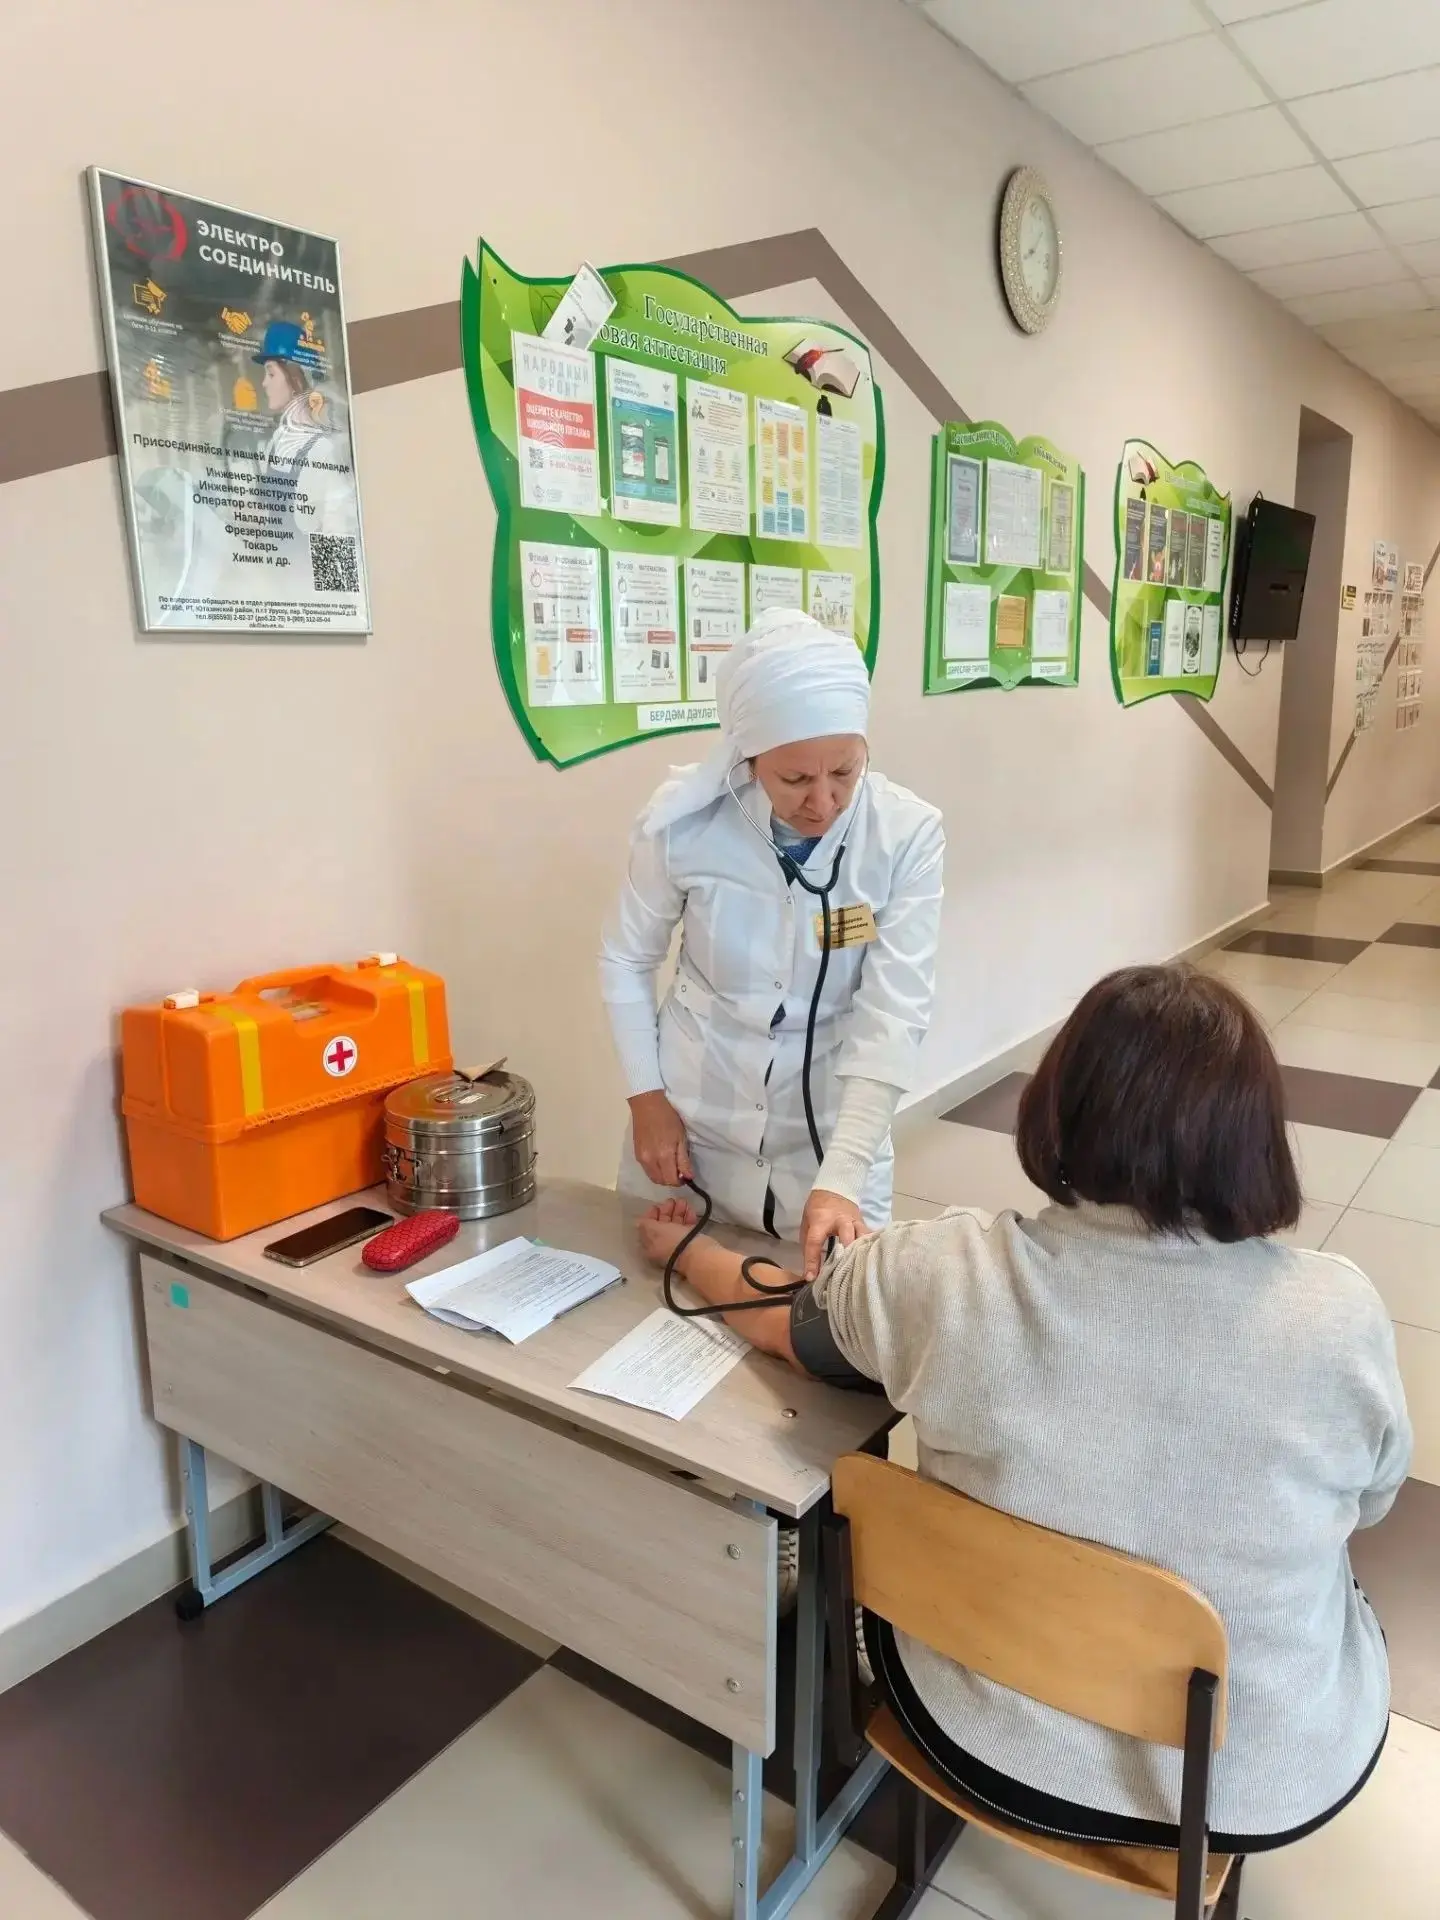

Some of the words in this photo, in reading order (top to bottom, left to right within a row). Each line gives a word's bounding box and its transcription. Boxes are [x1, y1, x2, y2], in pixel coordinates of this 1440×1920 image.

[197, 219, 275, 257] ЭЛЕКТРО
[199, 244, 336, 294] СОЕДИНИТЕЛЬ
[643, 293, 769, 356] Государственная
[600, 324, 639, 351] овая
[643, 334, 728, 376] аттестация
[133, 433, 222, 456] Присоединяйся
[233, 449, 266, 461] нашей
[268, 454, 310, 468] дружной
[312, 459, 350, 473] команде
[206, 466, 298, 488] Инженер-технолог
[199, 480, 308, 502] Инженер-конструктор
[193, 493, 245, 508] Оператор
[247, 500, 287, 512] станков
[289, 504, 295, 513] с
[297, 505, 316, 516] ЧПУ
[234, 511, 283, 526] Наладчик
[225, 524, 294, 540] Фрезеровщик
[243, 539, 278, 552] Токарь
[232, 552, 264, 564] Химик
[266, 557, 273, 565] и
[275, 557, 291, 568] др.
